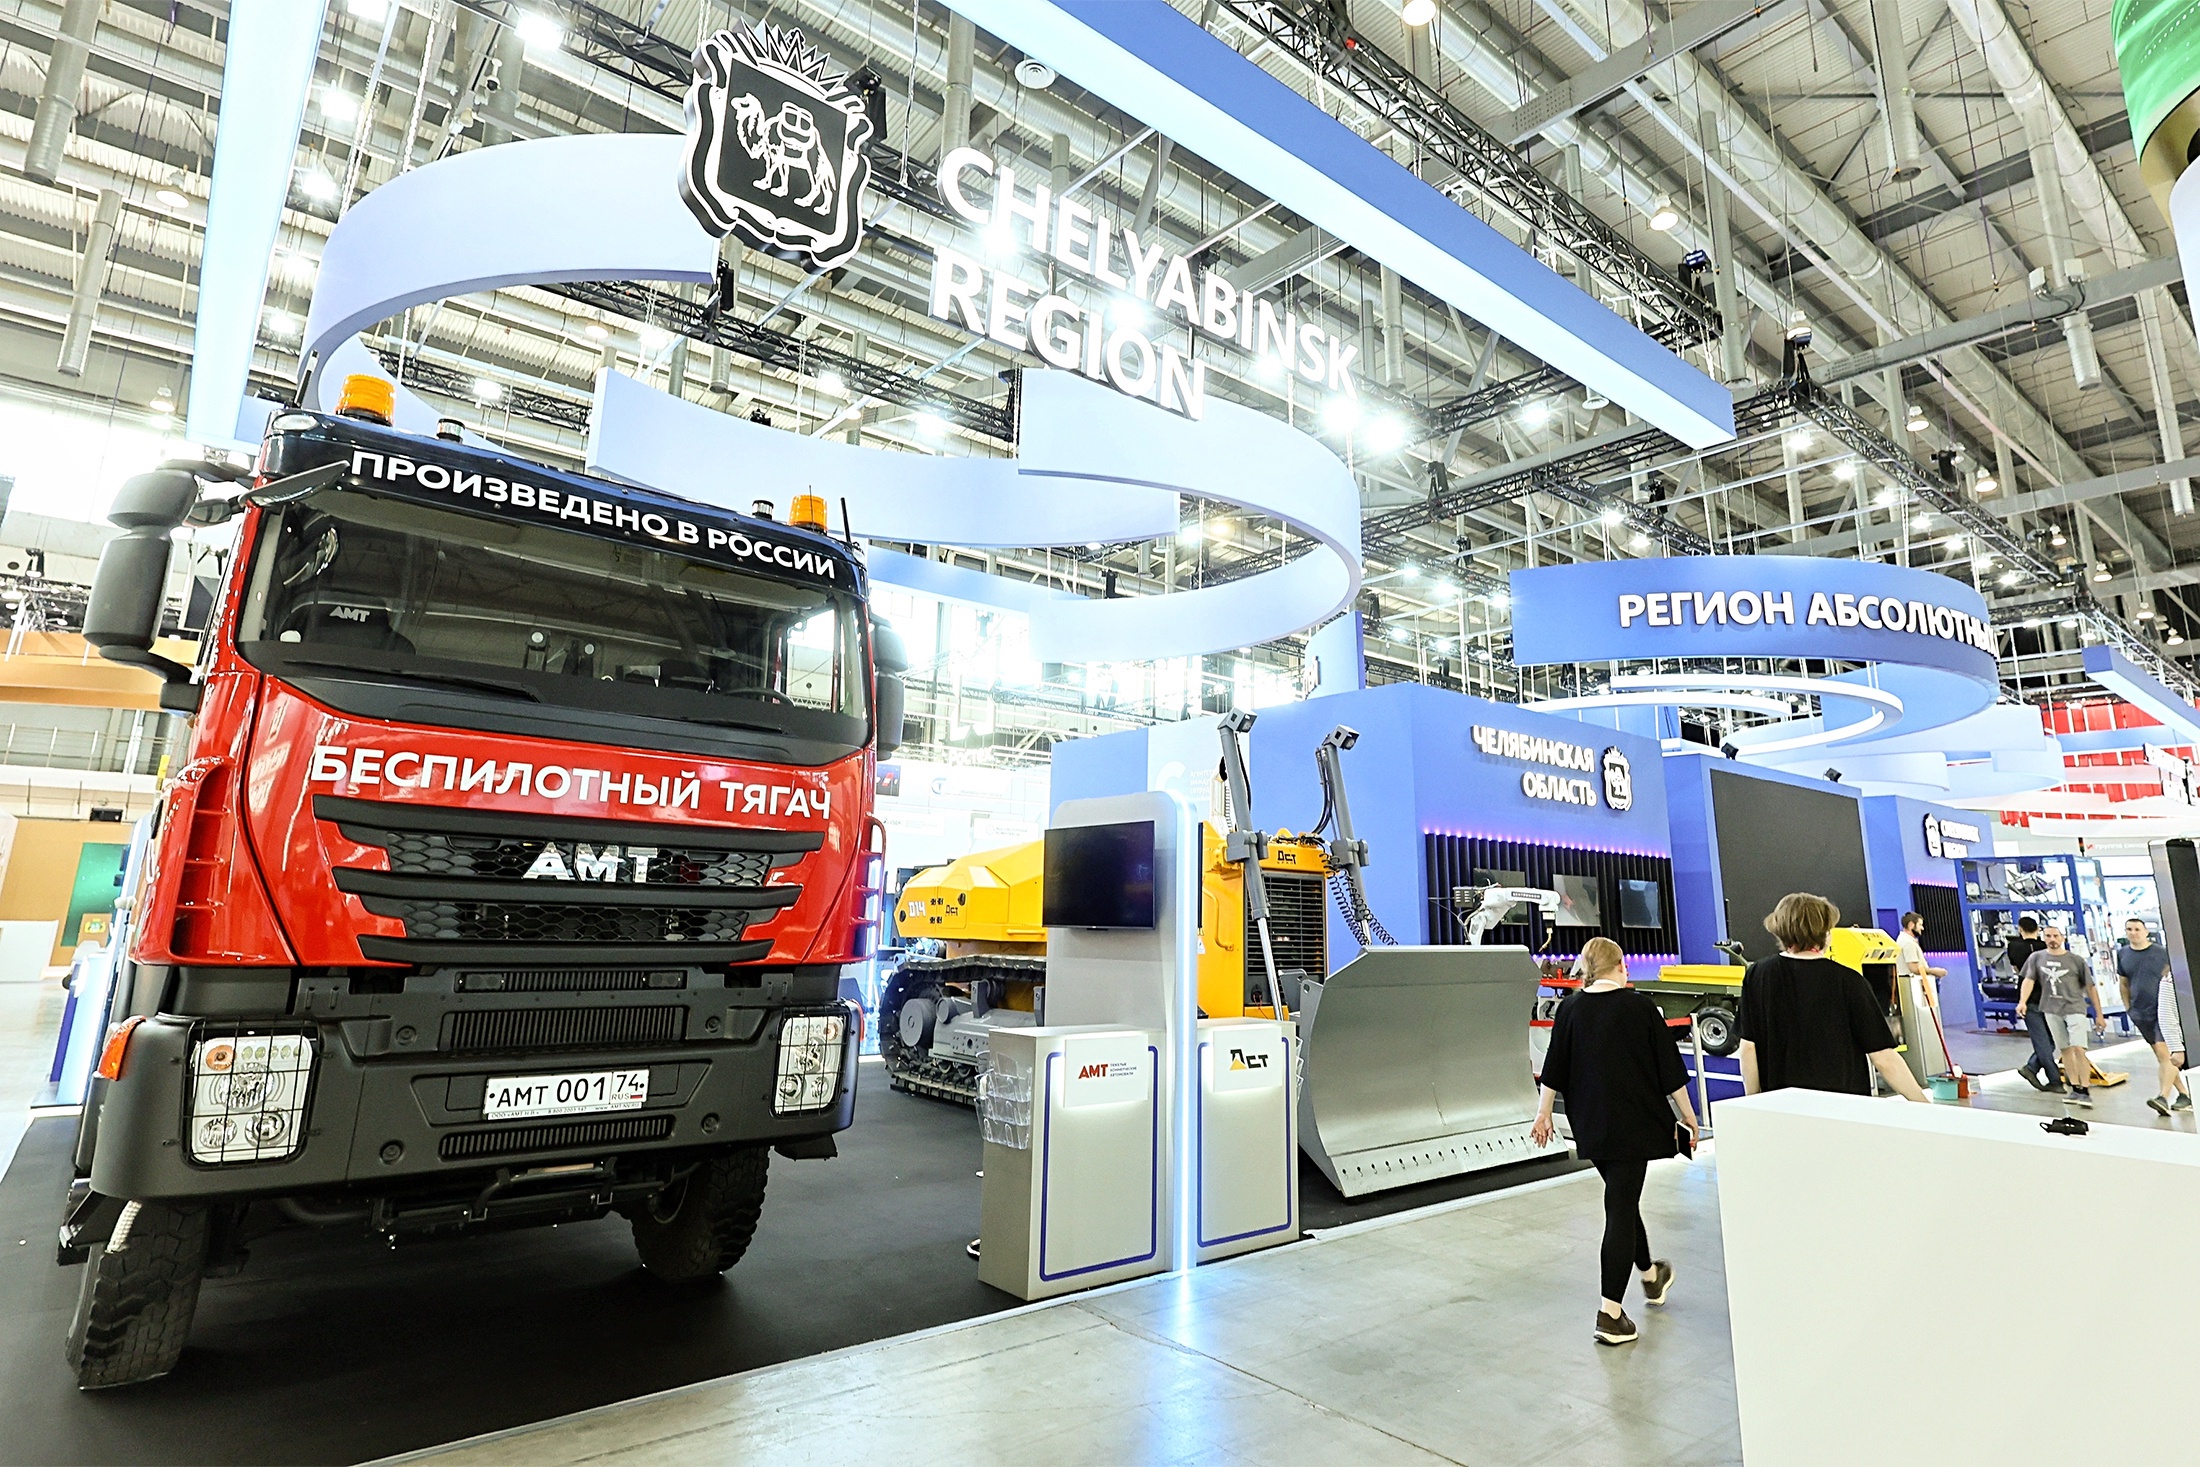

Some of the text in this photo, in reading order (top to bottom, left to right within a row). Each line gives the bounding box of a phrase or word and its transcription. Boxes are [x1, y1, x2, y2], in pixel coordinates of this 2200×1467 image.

[937, 147, 1358, 398] CHELYABINSK
[929, 244, 1205, 422] REGION
[351, 450, 836, 579] ПРОИЗВЕДЕНО В РОССИИ
[1618, 590, 1795, 629] РЕГИОН
[1471, 724, 1595, 773] ЧЕЛЯБИНСКАЯ
[310, 745, 831, 820] БЕСПИЛОТНЫЙ ТЯГАЧ
[1520, 771, 1598, 807] ОБЛАСТЬ
[556, 1077, 606, 1103] 001
[615, 1073, 639, 1093] 74
[611, 1093, 630, 1101] RUS
